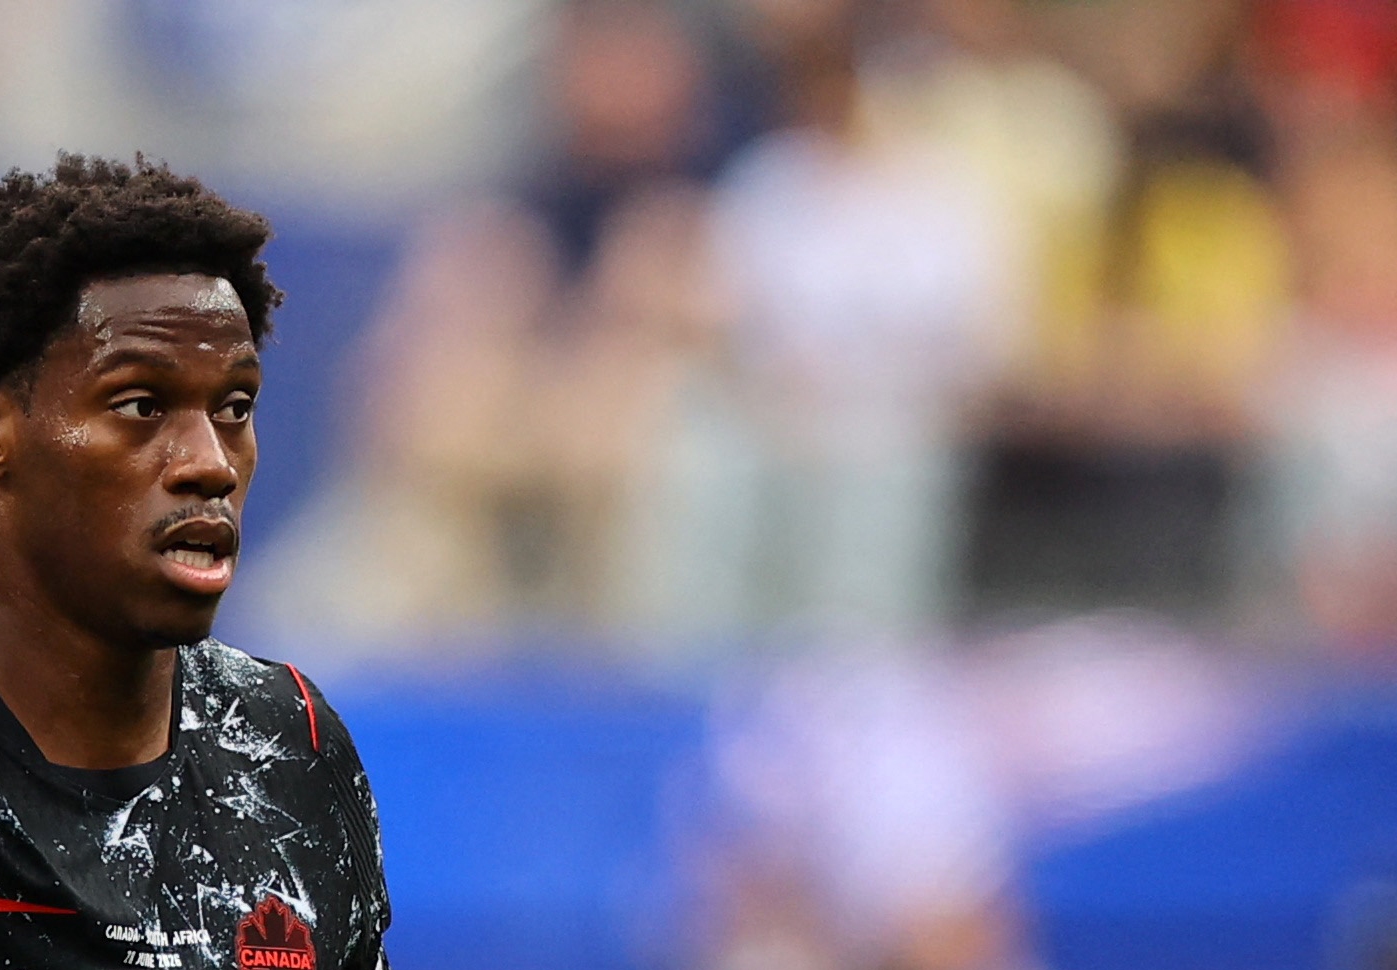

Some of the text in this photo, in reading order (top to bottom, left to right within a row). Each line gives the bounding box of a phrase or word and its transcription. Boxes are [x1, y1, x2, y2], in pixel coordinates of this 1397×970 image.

[105, 925, 139, 943] CANADA
[172, 929, 212, 946] AFRICA
[241, 949, 312, 969] CANADA
